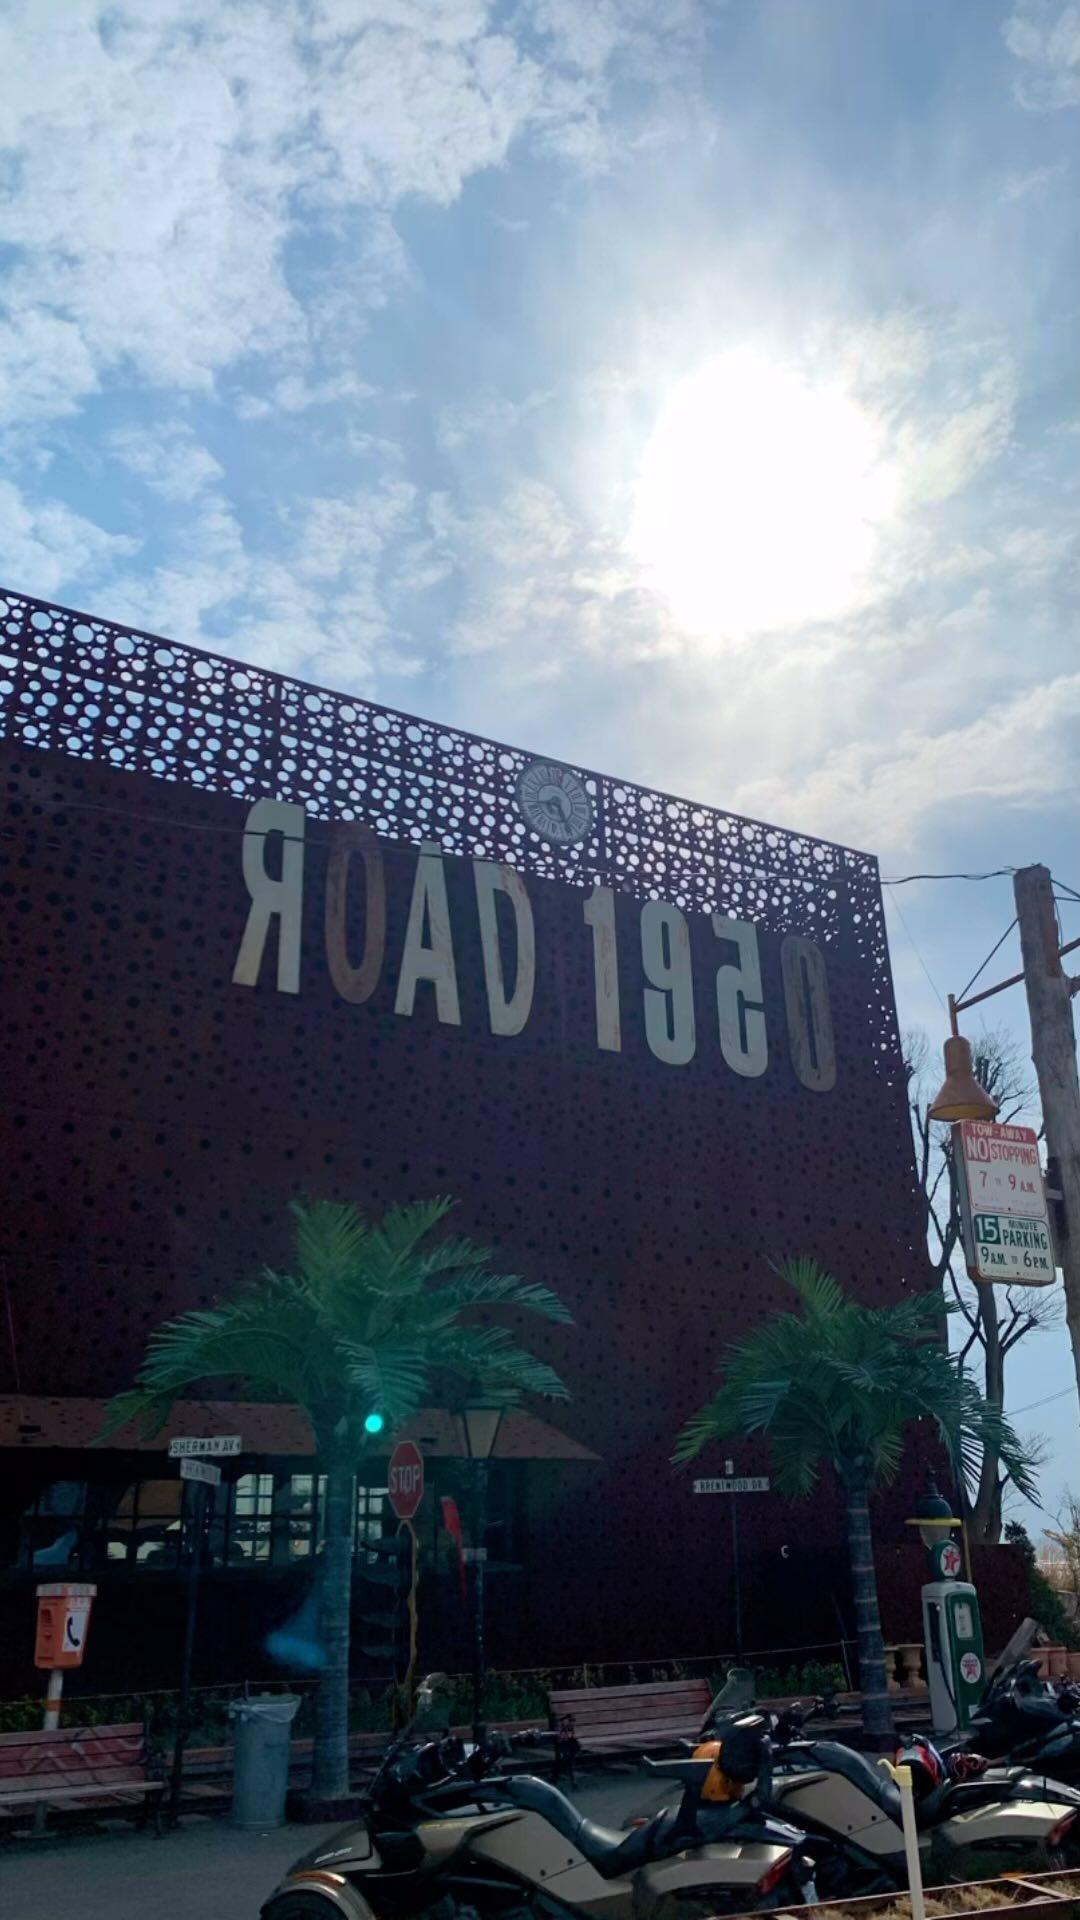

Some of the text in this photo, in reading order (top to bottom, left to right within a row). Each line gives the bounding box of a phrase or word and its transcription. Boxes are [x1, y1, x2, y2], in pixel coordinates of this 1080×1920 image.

[231, 799, 838, 1092] ROAD 1950
[966, 1136, 1037, 1165] NO STOPPING
[979, 1170, 988, 1188] 7
[1008, 1173, 1017, 1191] 9
[976, 1217, 1038, 1242] 15 MINUTE
[1002, 1229, 1048, 1250] PARKING
[172, 1440, 219, 1454] SHERMAN
[390, 1465, 421, 1494] STOP
